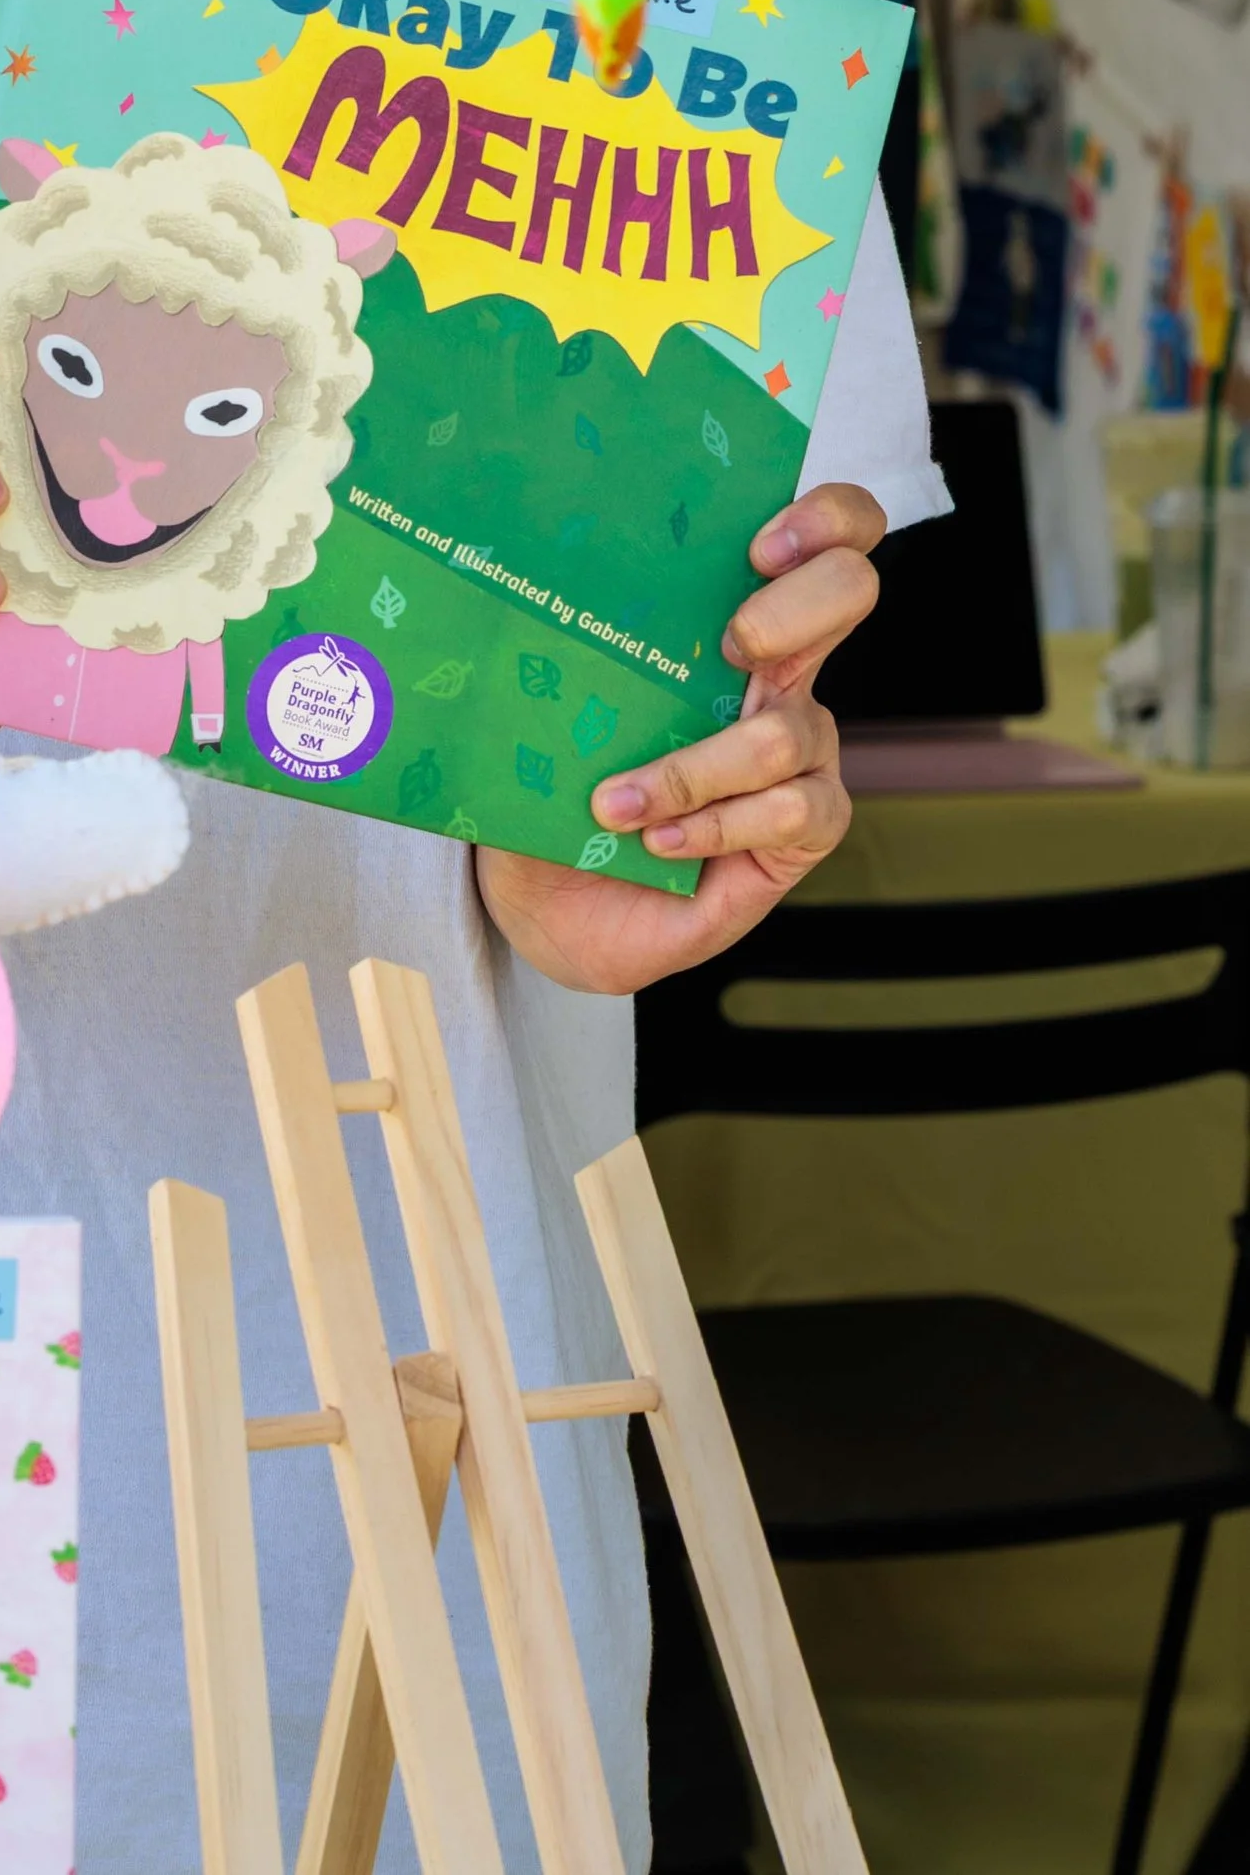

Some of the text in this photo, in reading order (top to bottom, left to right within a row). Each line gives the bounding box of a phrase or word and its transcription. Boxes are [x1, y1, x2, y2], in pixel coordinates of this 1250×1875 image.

[542, 8, 654, 99] To
[676, 46, 798, 139] Be
[281, 45, 760, 282] MEHHH
[348, 485, 691, 683] Written and Illustrated by Gabriel Park
[287, 694, 355, 725] Dragonfly
[291, 681, 337, 705] Purple
[283, 708, 351, 738] Book Award
[298, 732, 325, 752] SM
[270, 744, 341, 779] WINNER
